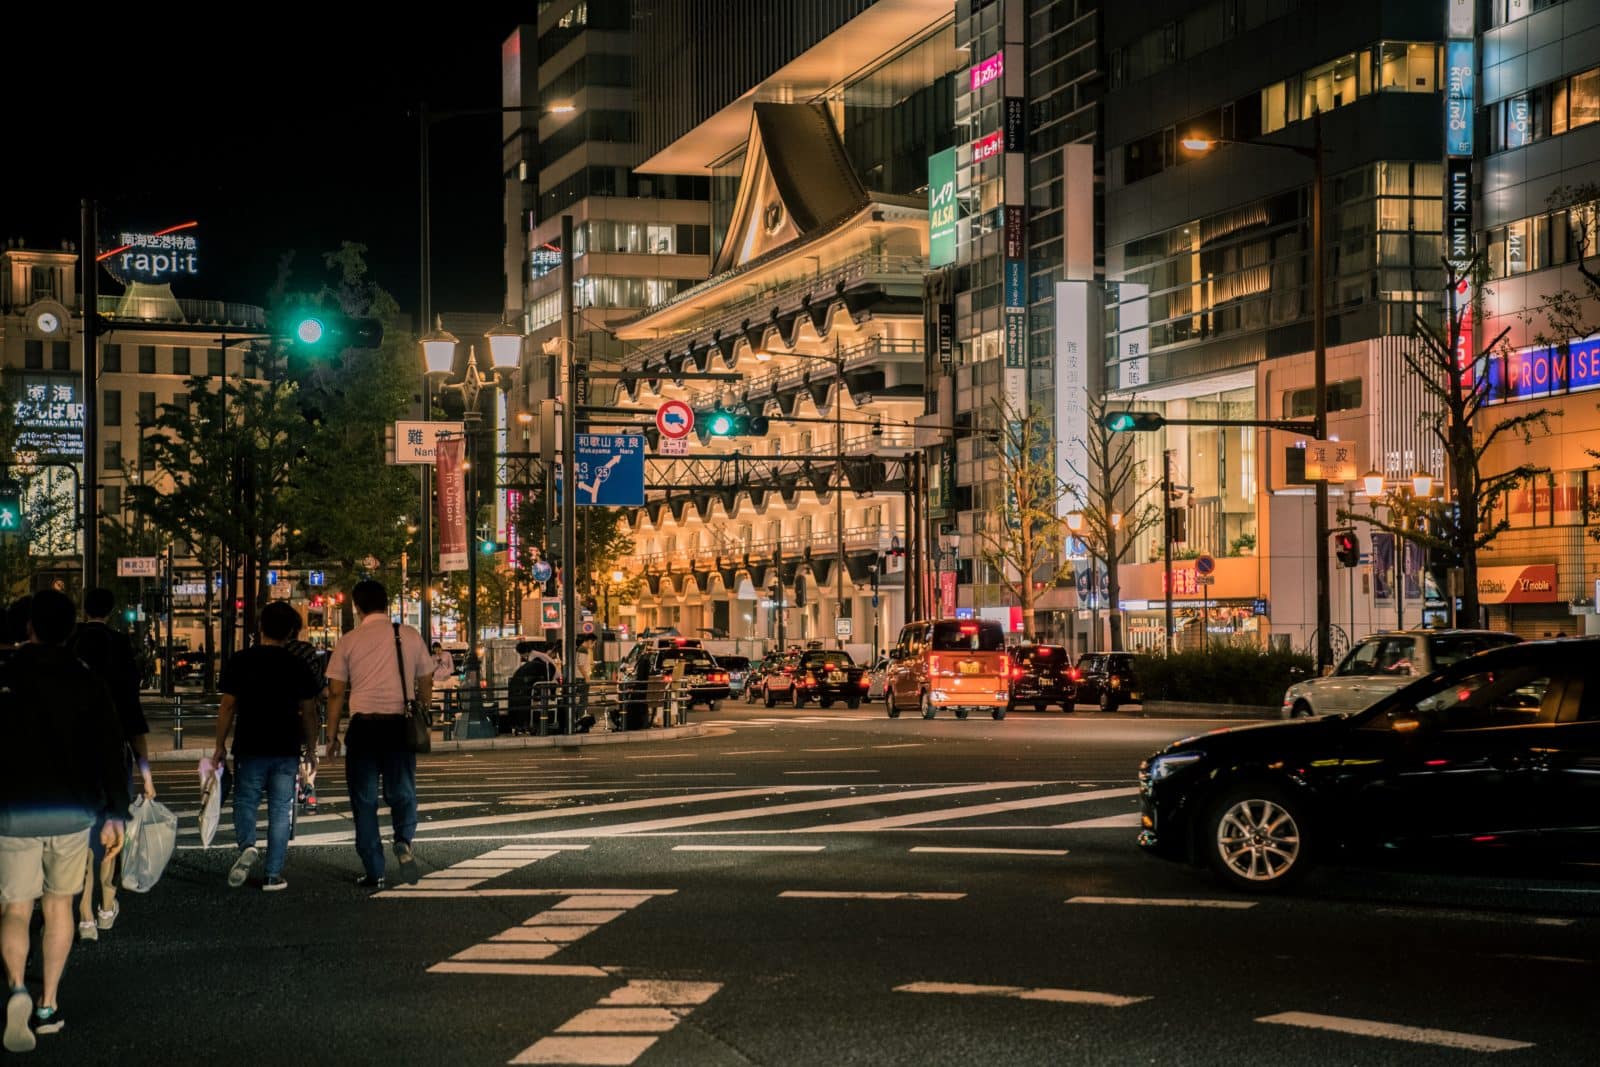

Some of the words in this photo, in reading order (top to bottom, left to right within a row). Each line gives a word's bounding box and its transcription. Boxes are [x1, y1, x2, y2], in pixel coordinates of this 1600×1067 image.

[1450, 66, 1460, 130] KIREIMO
[931, 181, 953, 208] レイク
[1454, 172, 1466, 211] LINK
[931, 204, 955, 230] ALSA
[1454, 218, 1466, 256] LINK
[1508, 347, 1600, 390] PROMISE
[579, 436, 611, 447] 和歌山
[615, 437, 639, 448] 奈良
[579, 447, 612, 455] Wakayama
[597, 468, 608, 477] 25
